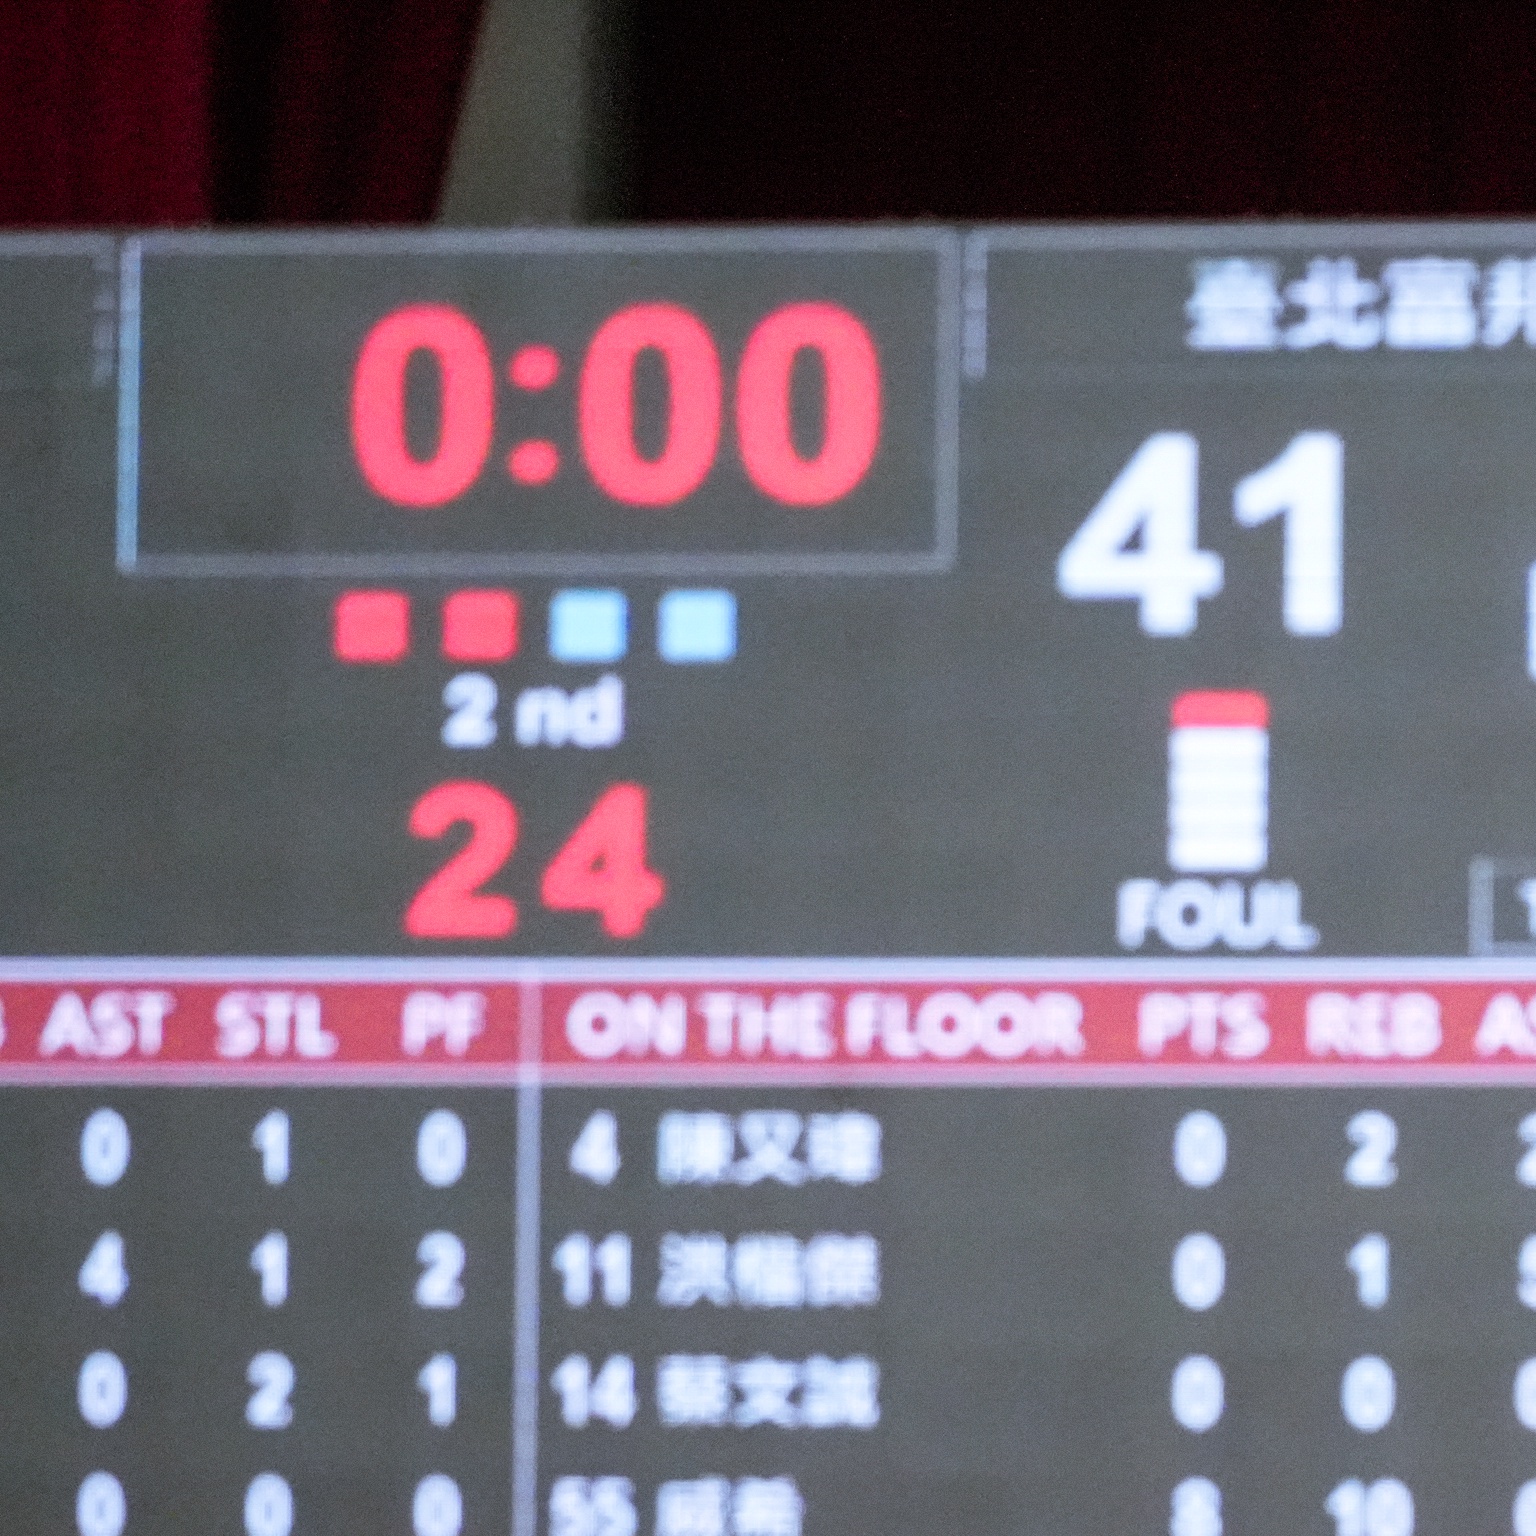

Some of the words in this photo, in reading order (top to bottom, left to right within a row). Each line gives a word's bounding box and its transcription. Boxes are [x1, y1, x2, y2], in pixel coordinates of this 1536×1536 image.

[349, 301, 884, 509] 0:00
[1056, 431, 1346, 638] 41
[440, 672, 499, 749] 2
[514, 674, 625, 749] nd
[402, 779, 667, 941] 24
[1113, 876, 1322, 953] FOUL
[38, 988, 177, 1060] AST
[212, 988, 340, 1061] STL
[398, 988, 489, 1058] PF
[563, 988, 689, 1061] ON
[695, 988, 837, 1061] THE
[842, 987, 1088, 1062] FLOOR
[1135, 988, 1273, 1062] PTS
[1302, 988, 1445, 1062] REB
[78, 1107, 132, 1188] 0
[251, 1109, 292, 1187] 1
[414, 1107, 469, 1189] 0
[567, 1109, 623, 1188] 4
[1170, 1107, 1230, 1191] 0
[1341, 1107, 1401, 1191] 2
[77, 1228, 130, 1309] 4
[249, 1228, 290, 1309] 1
[413, 1228, 467, 1311] 2
[550, 1230, 634, 1311] 11
[1168, 1230, 1228, 1314] 0
[1343, 1230, 1392, 1312] 1
[76, 1349, 129, 1431] 0
[243, 1349, 296, 1432] 2
[416, 1350, 458, 1431] 1
[549, 1351, 640, 1432] 14
[1167, 1351, 1227, 1436] 0
[1338, 1351, 1399, 1436] 0
